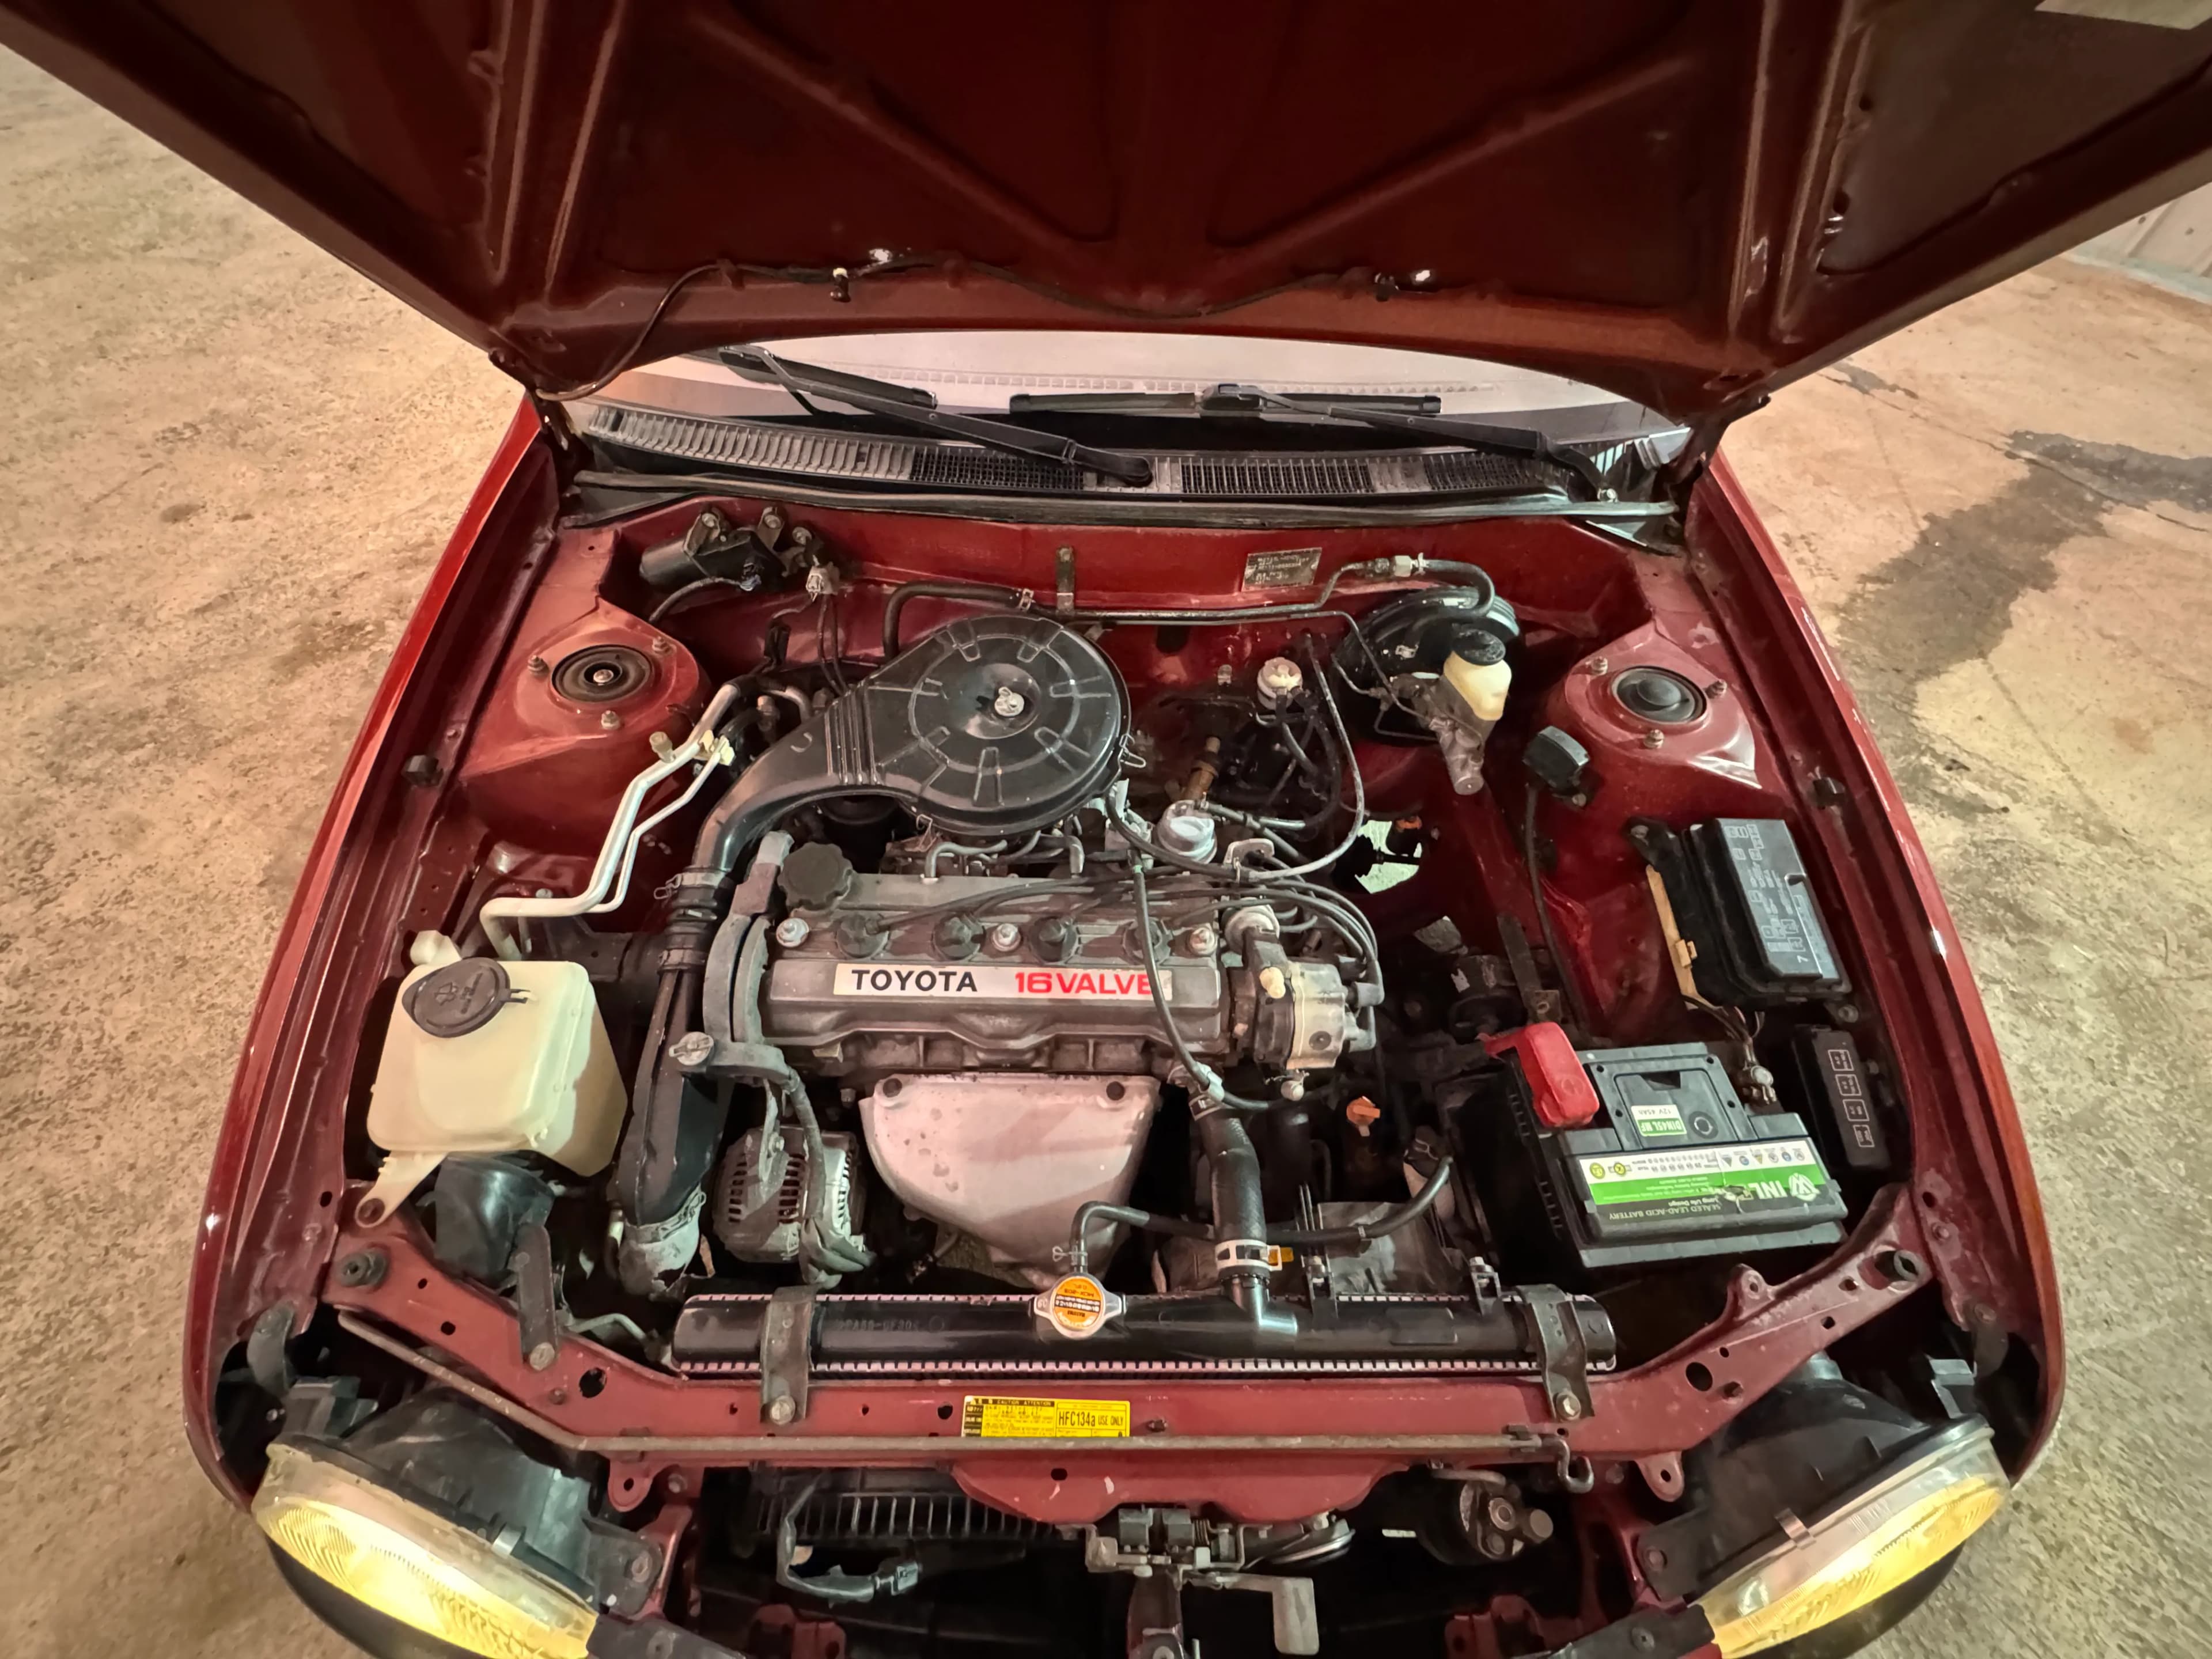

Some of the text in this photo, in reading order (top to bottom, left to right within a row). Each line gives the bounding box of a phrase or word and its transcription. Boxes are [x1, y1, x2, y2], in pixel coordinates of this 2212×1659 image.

[851, 969, 978, 993] TOYOTA
[1609, 1204, 1721, 1221] SEALED LEAD-ACID BATTERY
[1059, 1411, 1124, 1427] HFC134a USE ONLY
